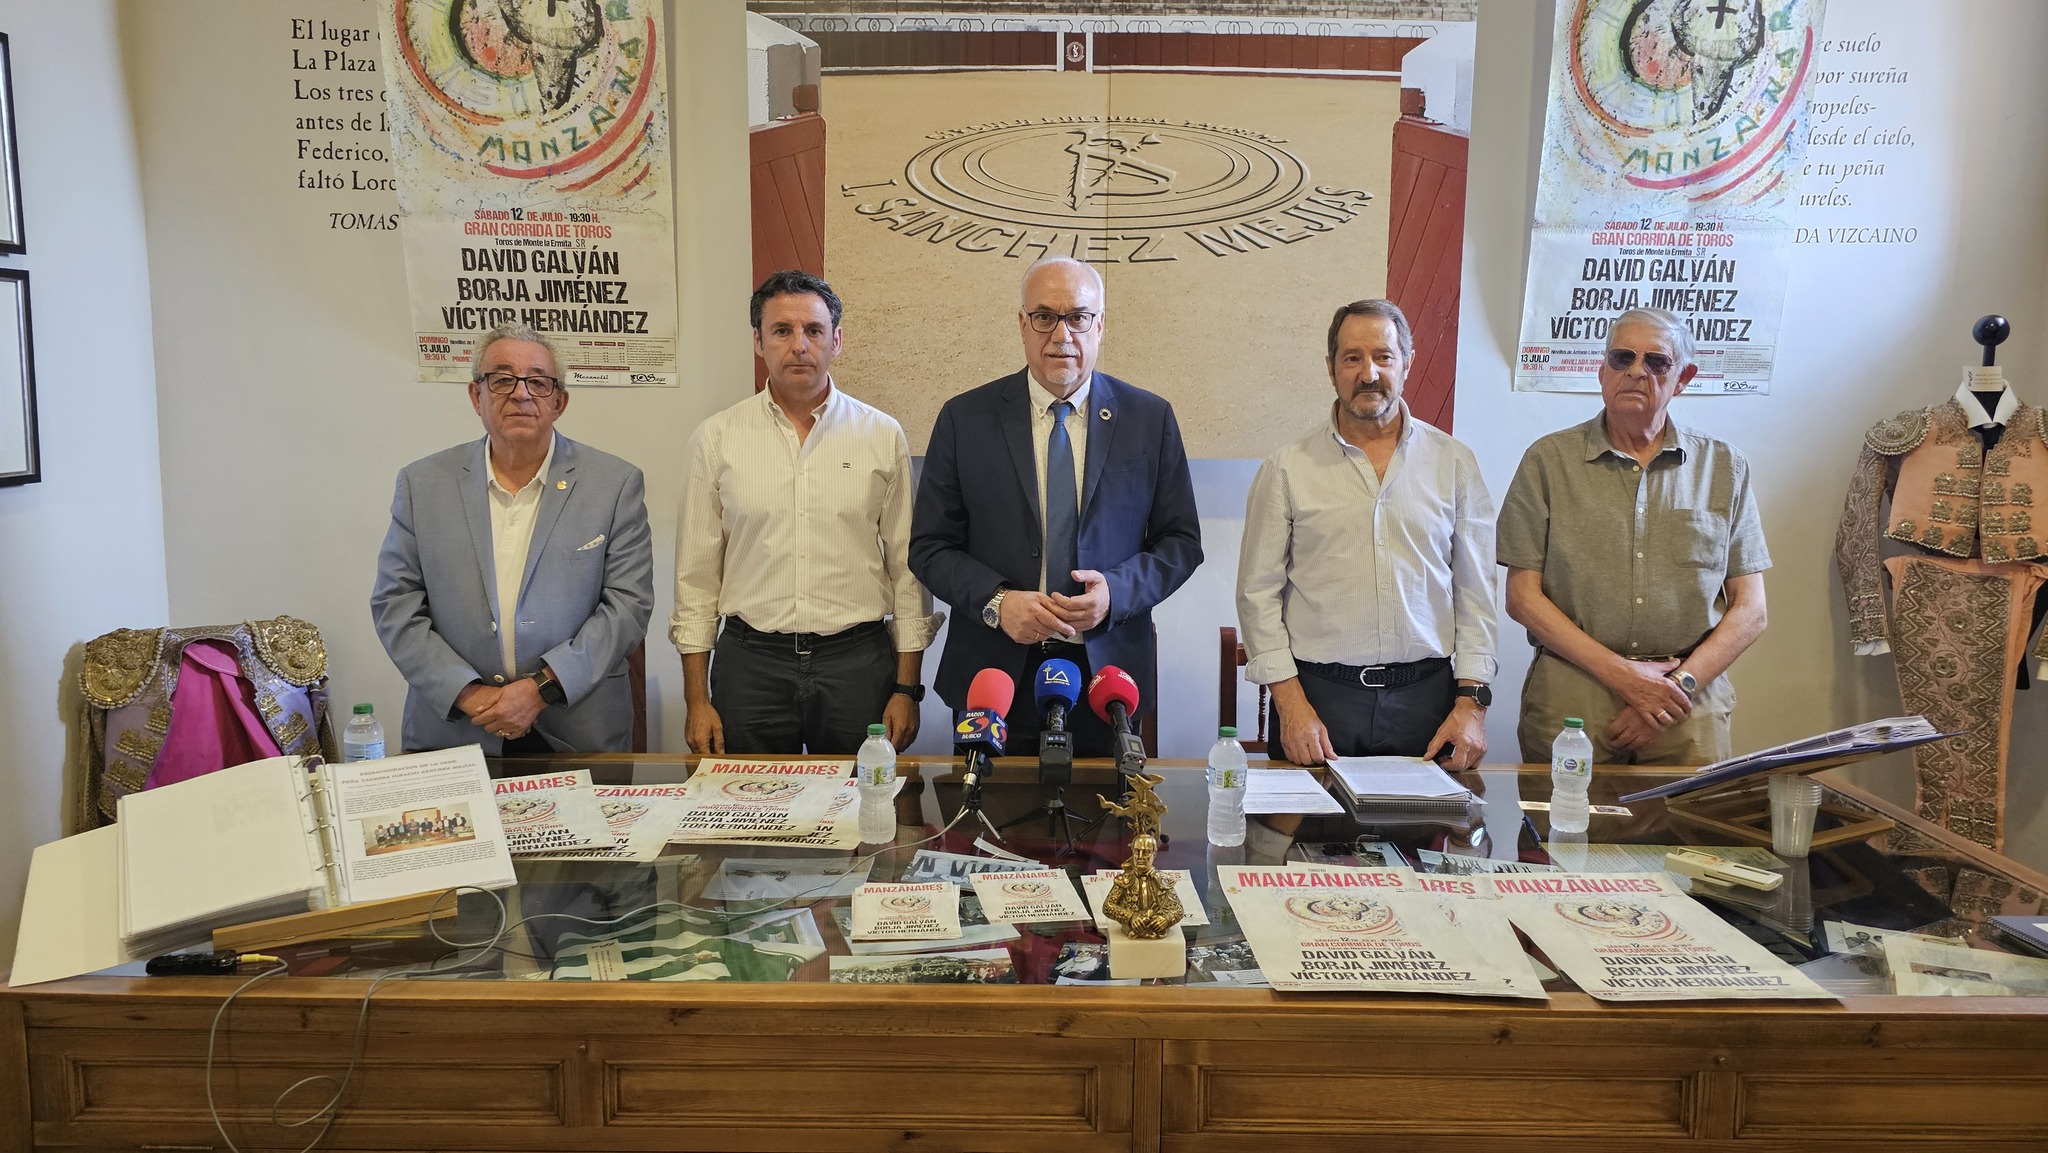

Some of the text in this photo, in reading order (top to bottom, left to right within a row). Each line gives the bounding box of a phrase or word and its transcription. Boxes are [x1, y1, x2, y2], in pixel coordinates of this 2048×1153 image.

[291, 19, 314, 40] El
[321, 20, 370, 47] lugar
[1837, 32, 1881, 52] suelo
[292, 49, 377, 72] La Plaza
[1849, 67, 1909, 84] sureña
[294, 79, 374, 102] Los tres
[1811, 95, 1877, 123] ropeles-
[296, 112, 373, 132] antes de
[1853, 126, 1872, 145] el
[1873, 126, 1916, 148] cielo,
[297, 139, 389, 163] Federico,
[298, 169, 345, 190] faltó
[1817, 161, 1836, 176] tu
[1835, 159, 1886, 184] peña
[1799, 187, 1852, 206] ureles.
[329, 212, 400, 231] TOMAS
[474, 207, 601, 223] SÁBADO 12 DE JULIO 19:30 H.
[464, 222, 612, 239] GRAN CORRIDA DE TOROS
[854, 197, 1178, 264] SANCHEZ
[1184, 185, 1374, 258] MEJIAS
[1604, 218, 1724, 232] SÁBADO 12 DE JULIO 19:30 H.
[495, 238, 513, 246] Toros
[523, 239, 543, 247] Monte
[544, 239, 550, 247] la
[551, 239, 572, 248] Ermita
[1592, 232, 1734, 247] GRAN CORRIDA DE TOROS
[1827, 227, 1918, 244] VIZCAINO
[461, 245, 619, 275] DAVID GALVÁN
[1645, 248, 1665, 256] Monte
[1582, 254, 1736, 283] DAVID GALVÁN
[457, 275, 629, 304] BORJA JIMÉNEZ
[1571, 283, 1738, 312] BORJA JIMÉNEZ
[441, 301, 649, 334] VÍCTOR HERNÁNDEZ
[419, 336, 448, 344] DOMINGO
[419, 344, 450, 353] 13 JULIO
[424, 353, 440, 361] 19:30
[1521, 354, 1550, 363] 13 JULIO
[711, 763, 840, 775] MANZANARES
[495, 775, 577, 795] ANARES
[594, 787, 688, 797] ZANARES
[982, 871, 1058, 880] MANZANARES
[1237, 872, 1403, 888] MANZANARES
[864, 883, 943, 894] MANZANARES
[1494, 879, 1663, 893] MANZANARES
[1301, 948, 1436, 959] DAVID GALVÁN
[1600, 954, 1737, 965] DAVID GALVÁN
[1301, 958, 1451, 970] BORJA JIMÉNEZ
[1605, 963, 1758, 976] BORJA JIMÉNEZ
[1290, 969, 1477, 981] VÍCTOR HERNÁNDEZ
[1600, 974, 1790, 988] VÍCTOR HERNÁNDEZ
